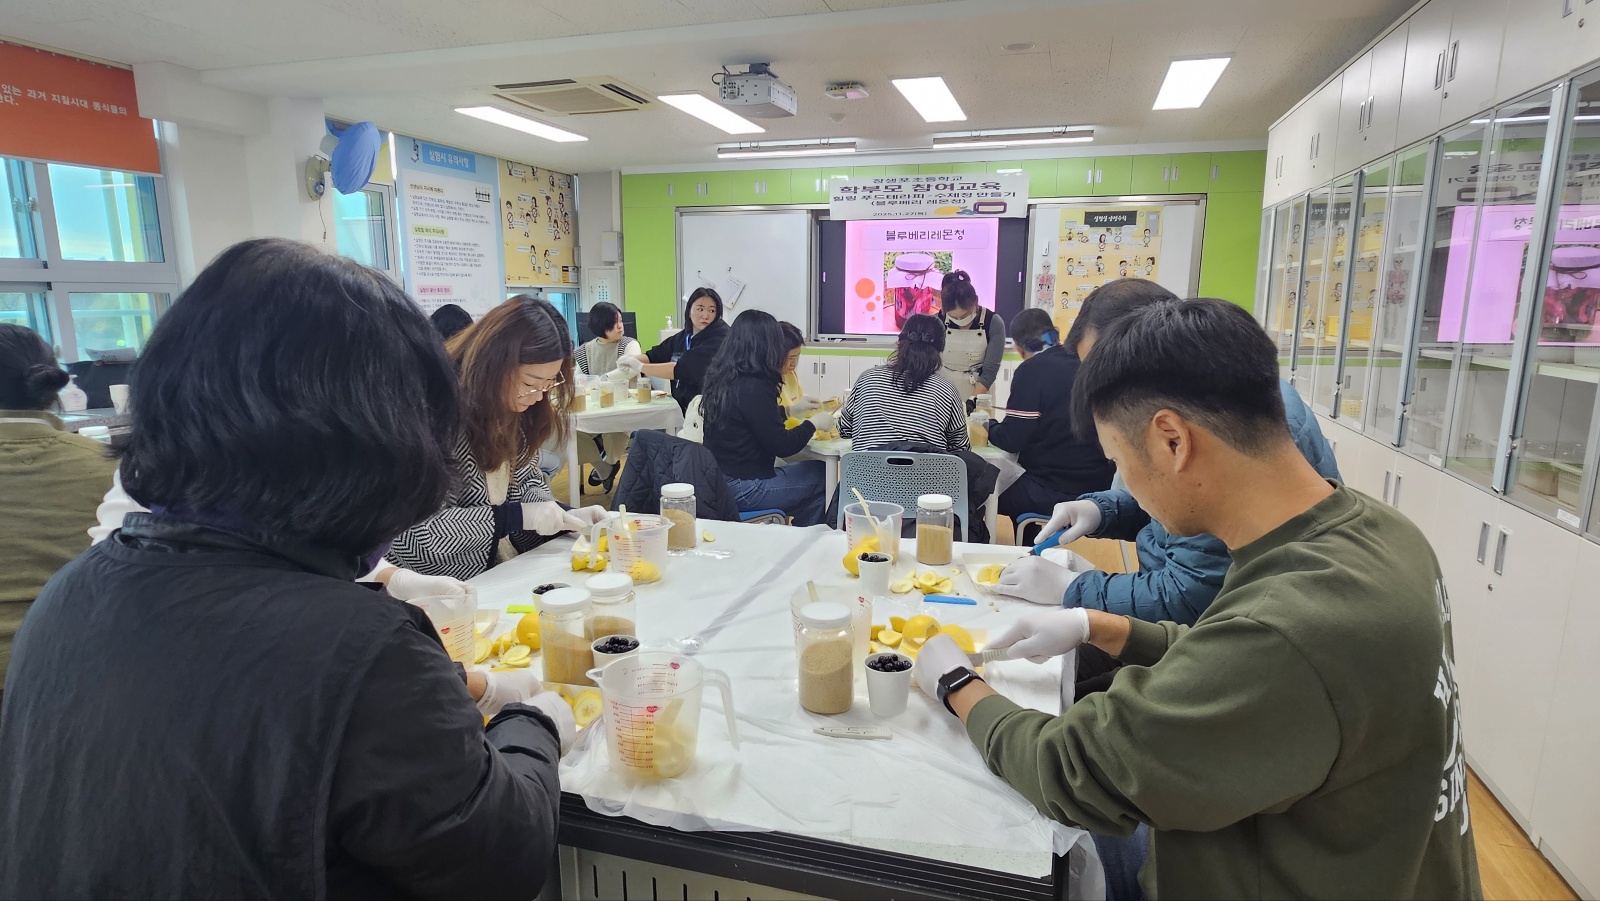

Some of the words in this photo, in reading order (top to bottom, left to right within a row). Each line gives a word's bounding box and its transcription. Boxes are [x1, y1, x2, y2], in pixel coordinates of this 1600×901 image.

[0, 93, 19, 106] 다.
[1, 84, 22, 96] 있는
[26, 88, 47, 101] 과거
[51, 93, 89, 109] 지질시대
[839, 185, 904, 194] 학부모
[911, 181, 1002, 193] 참여교육
[861, 193, 925, 201] 푸드테라피
[885, 229, 965, 241] 블루베리레몬청
